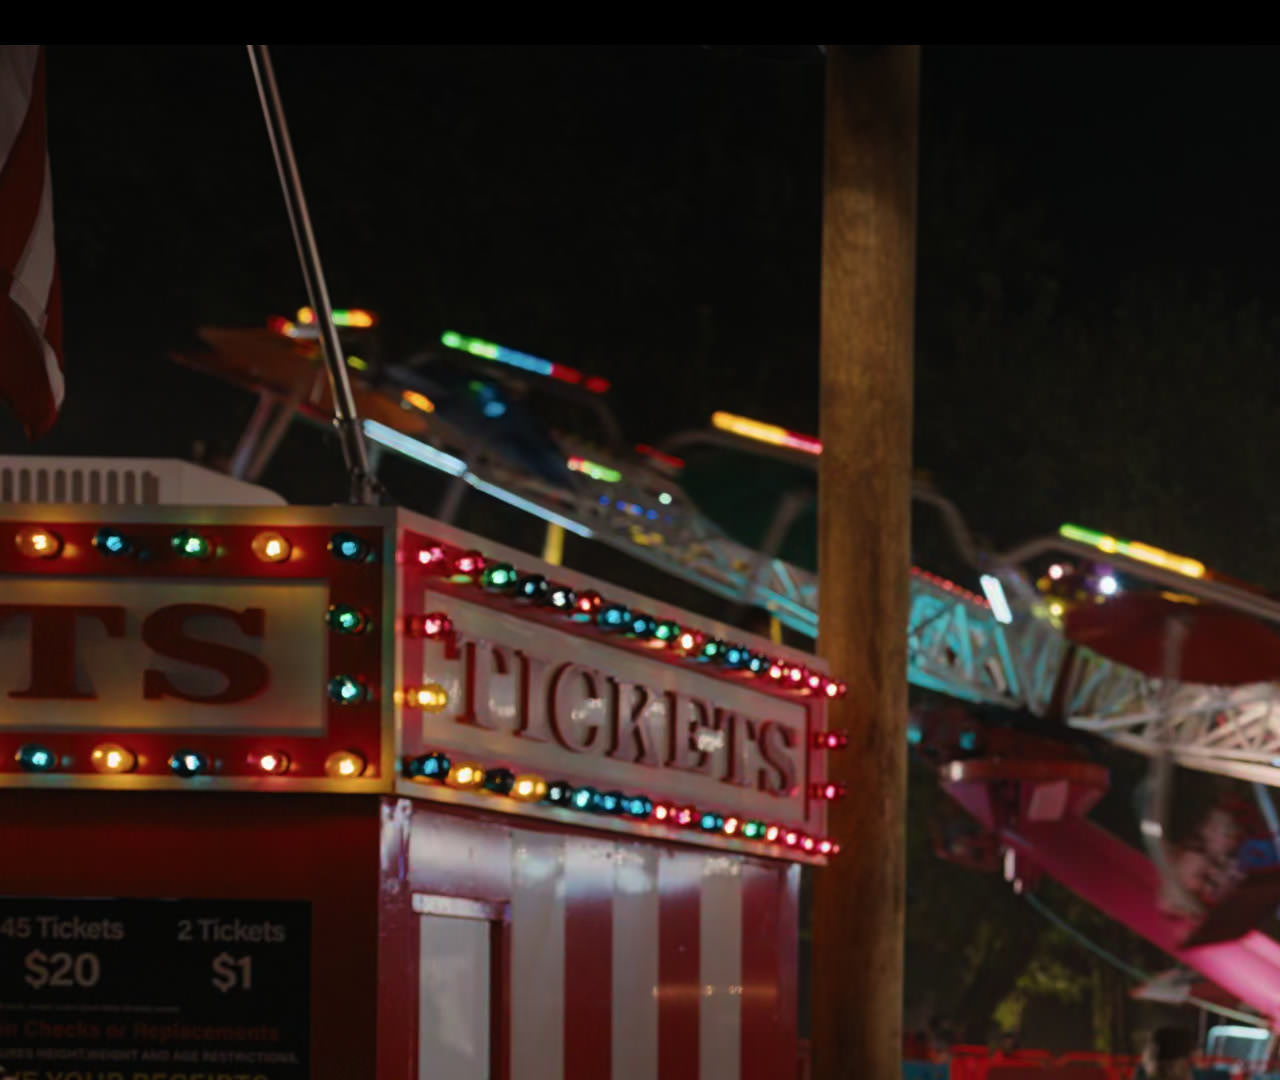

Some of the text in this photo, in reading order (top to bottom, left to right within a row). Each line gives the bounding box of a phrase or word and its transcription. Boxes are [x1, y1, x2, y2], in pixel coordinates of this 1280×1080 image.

[444, 630, 799, 800] TICKETS
[38, 914, 126, 941] Tickets
[177, 918, 287, 943] 2 Tickets
[24, 948, 102, 990] $20
[211, 951, 253, 993] $1
[24, 1020, 101, 1039] Checks
[133, 1022, 281, 1044] Replacements
